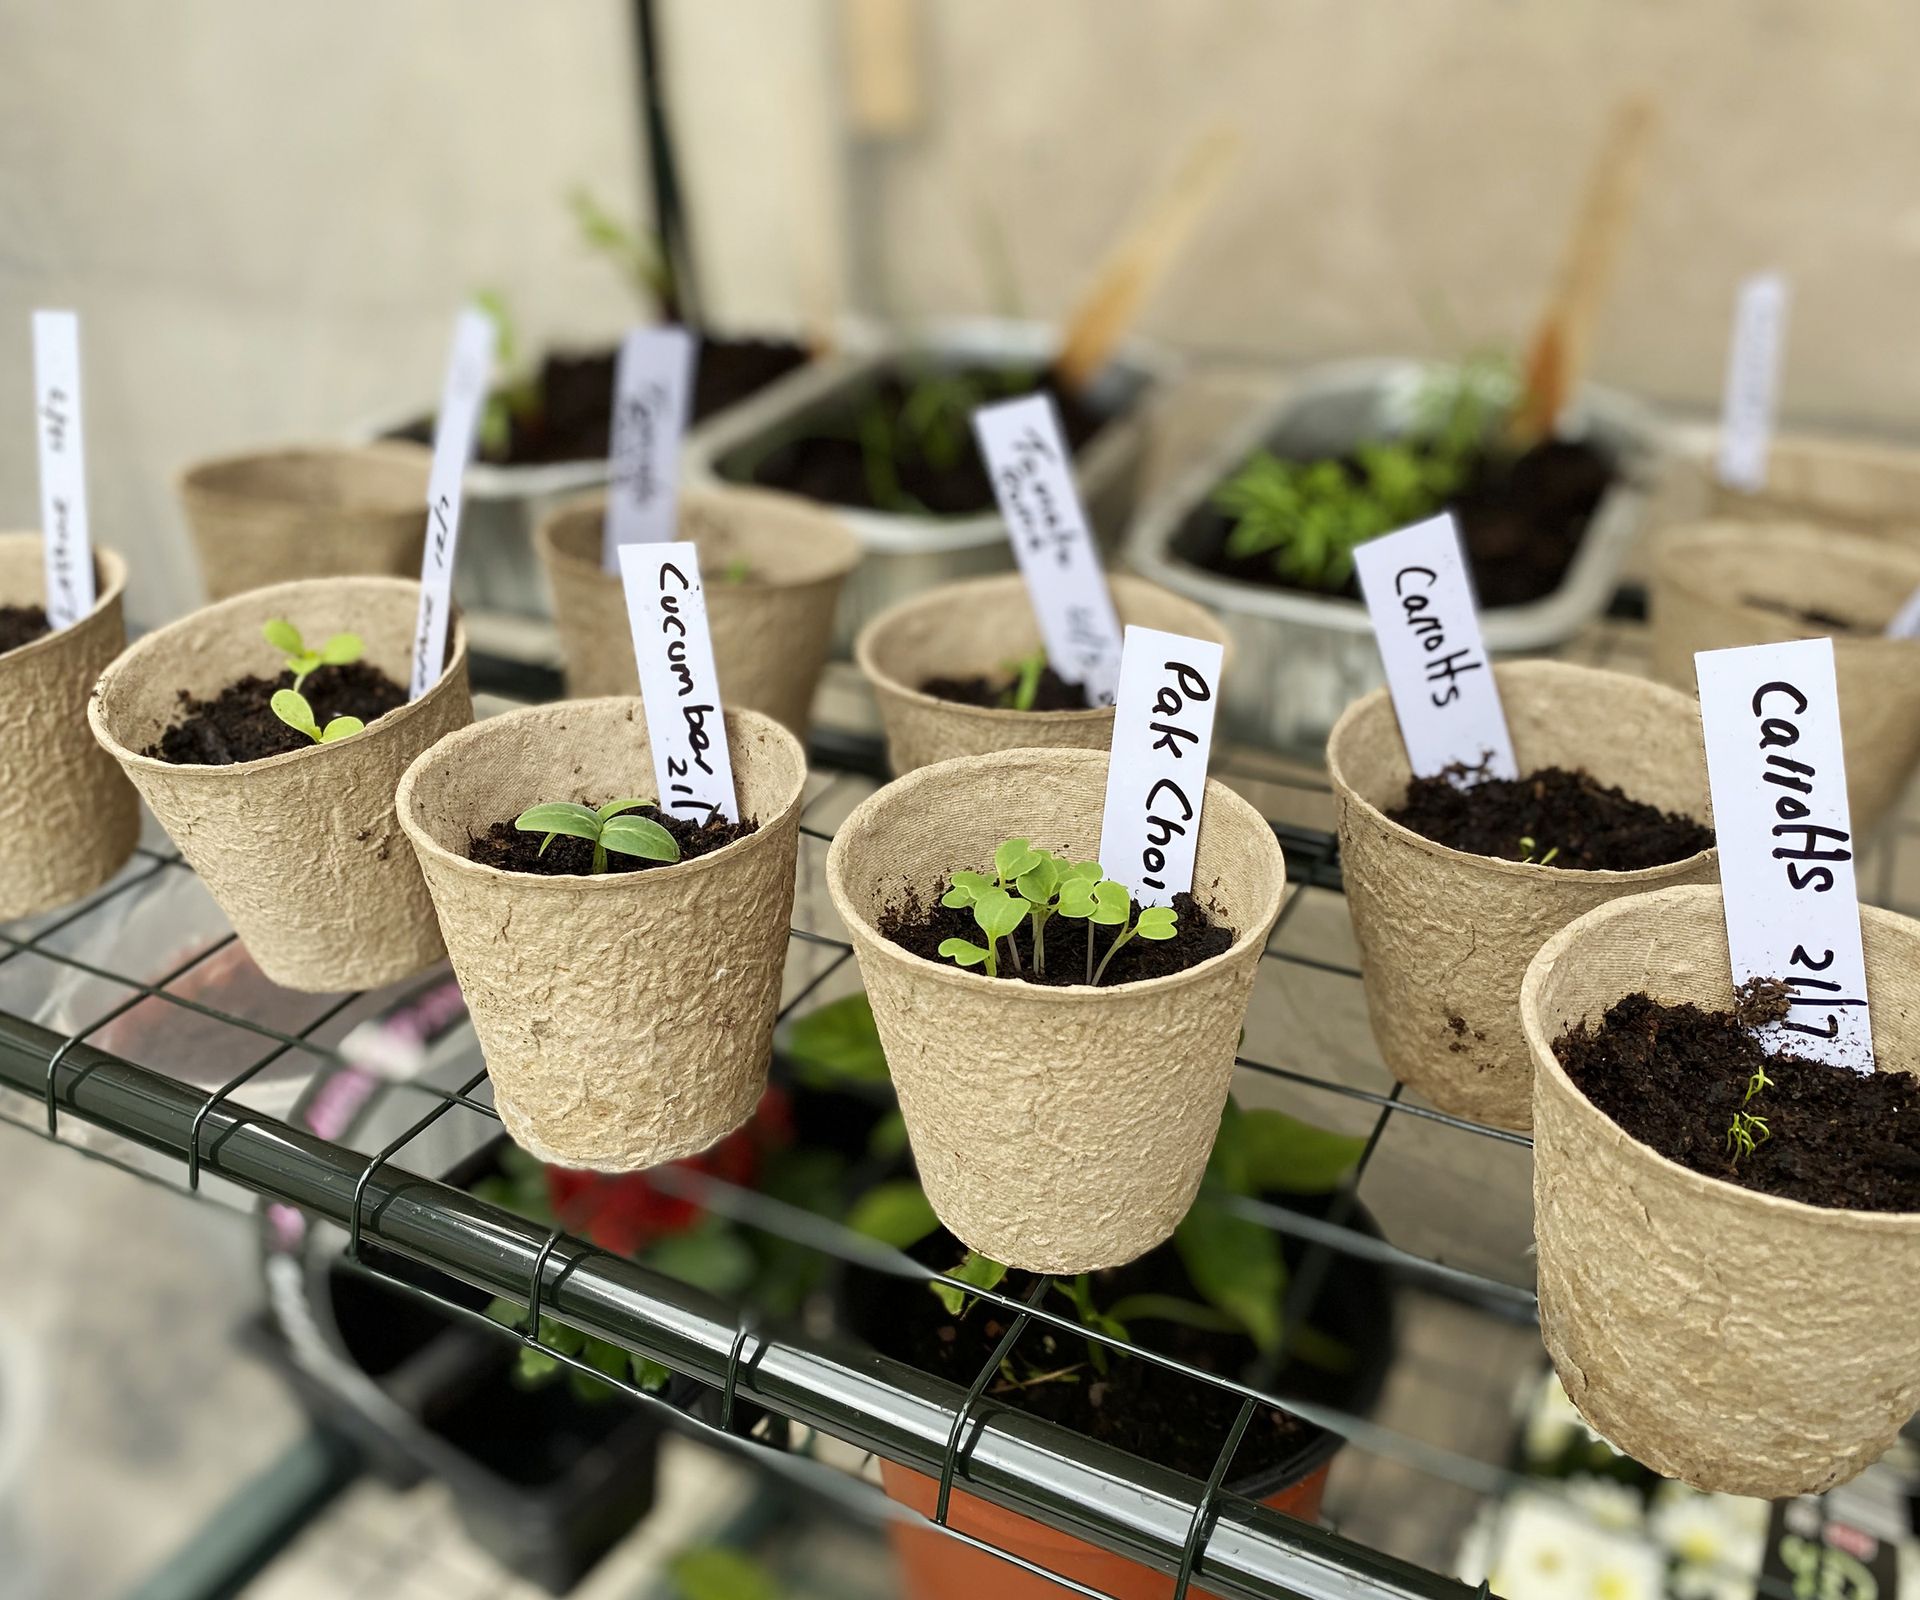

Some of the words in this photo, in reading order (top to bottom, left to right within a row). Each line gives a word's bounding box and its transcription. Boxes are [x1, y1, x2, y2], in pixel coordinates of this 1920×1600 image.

[1148, 660, 1211, 759] Pak
[1142, 778, 1194, 890] Choi
[1783, 943, 1868, 1040] 21/7
